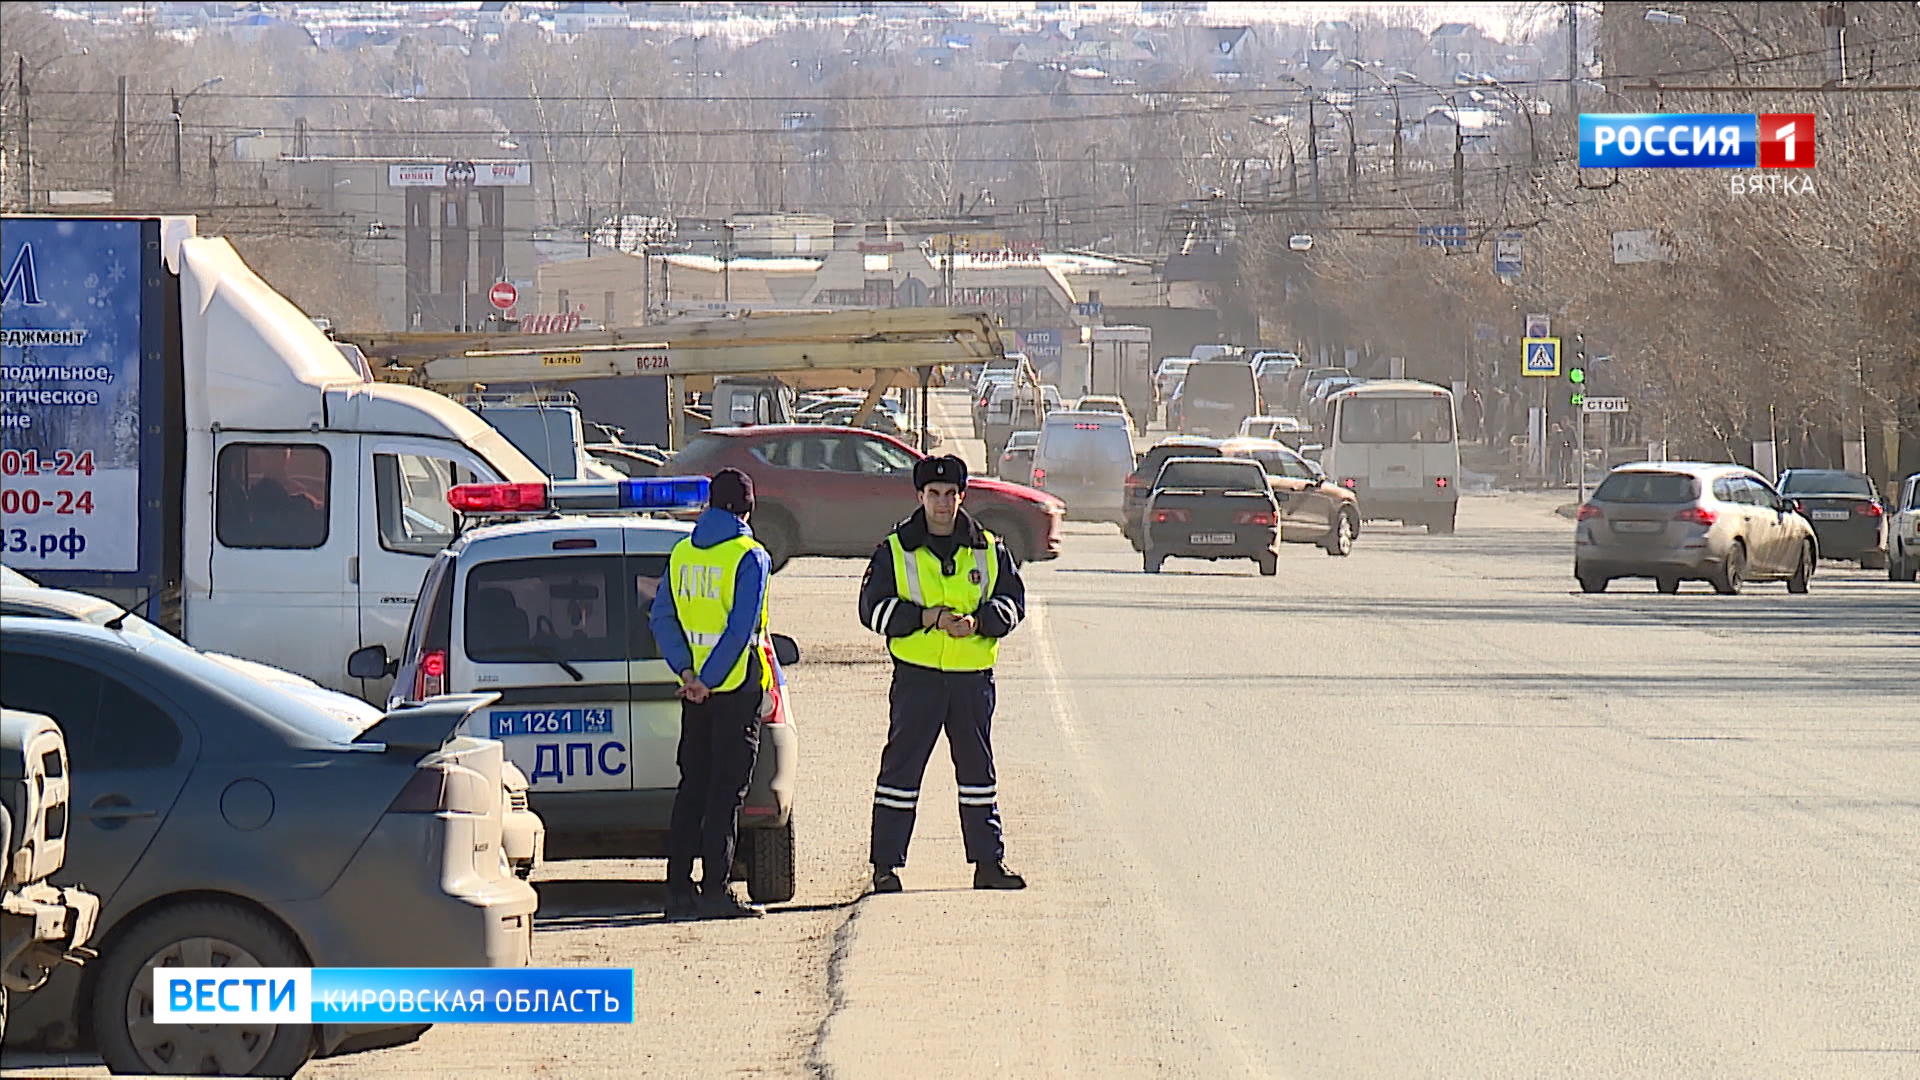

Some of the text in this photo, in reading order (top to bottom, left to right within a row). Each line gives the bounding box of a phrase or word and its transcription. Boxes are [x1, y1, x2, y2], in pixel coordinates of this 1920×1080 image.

[1587, 399, 1624, 410] СТОП
[678, 564, 724, 602] ДПС
[521, 711, 572, 733] 1261
[585, 709, 606, 726] 43
[530, 740, 627, 784] ДПС
